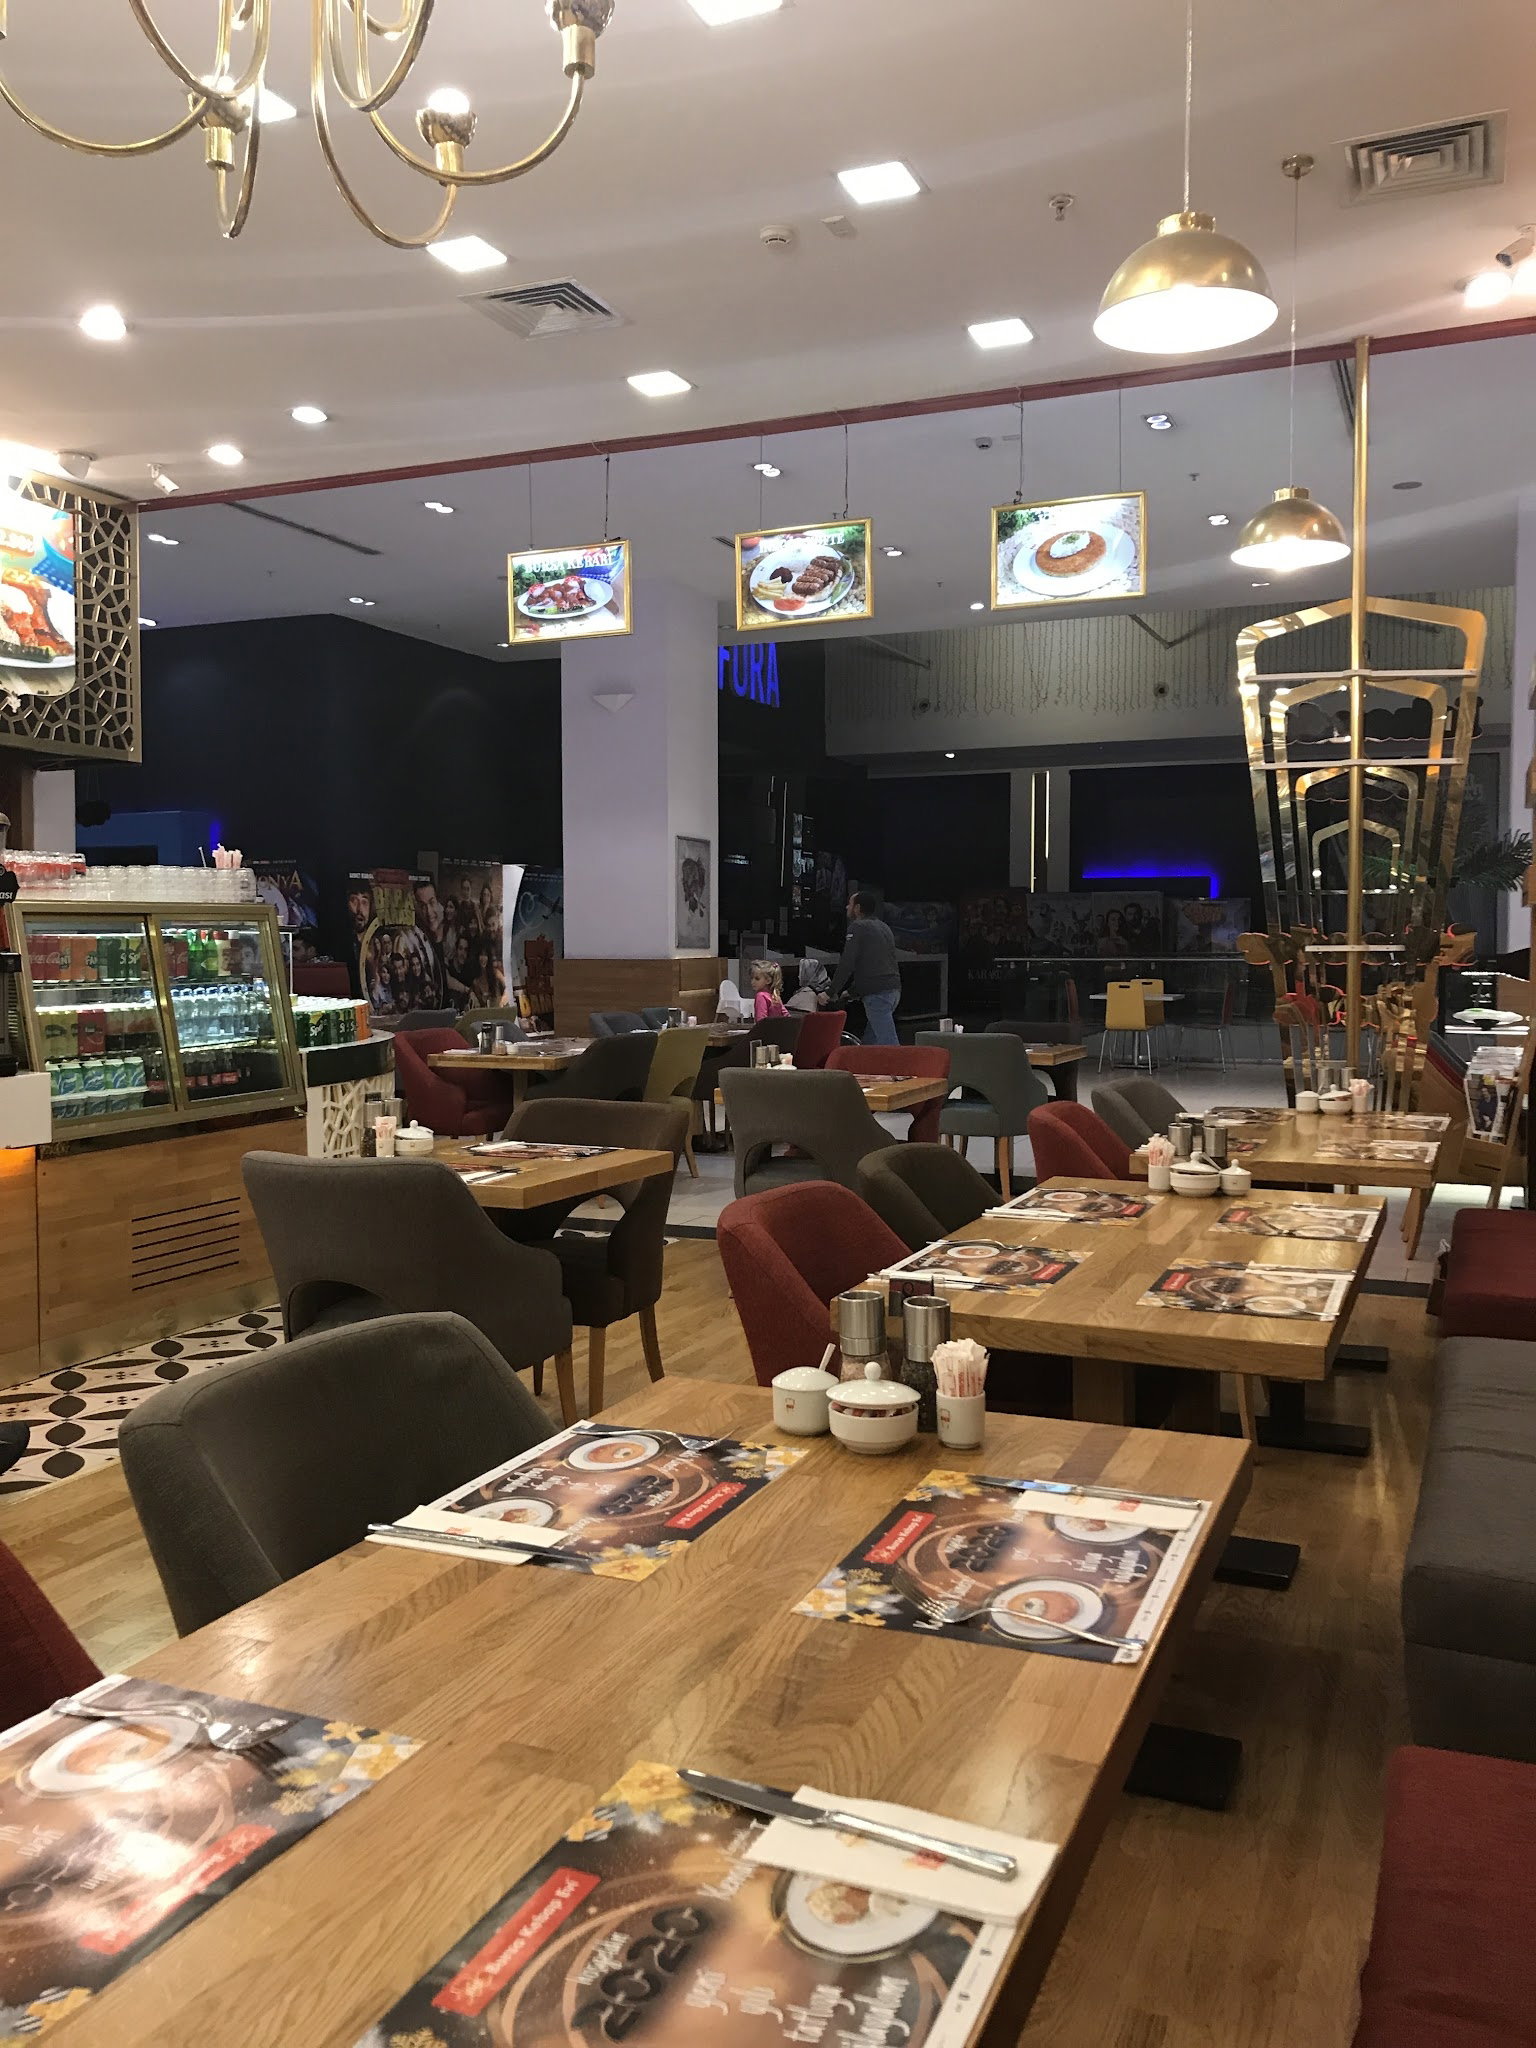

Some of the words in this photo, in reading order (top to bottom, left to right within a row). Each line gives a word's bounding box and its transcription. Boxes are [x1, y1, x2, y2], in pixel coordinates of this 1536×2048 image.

[484, 1937, 527, 1974] Bursa
[519, 1898, 563, 1938] Kebap
[554, 1875, 580, 1899] Evi
[567, 1905, 708, 2044] 2020
